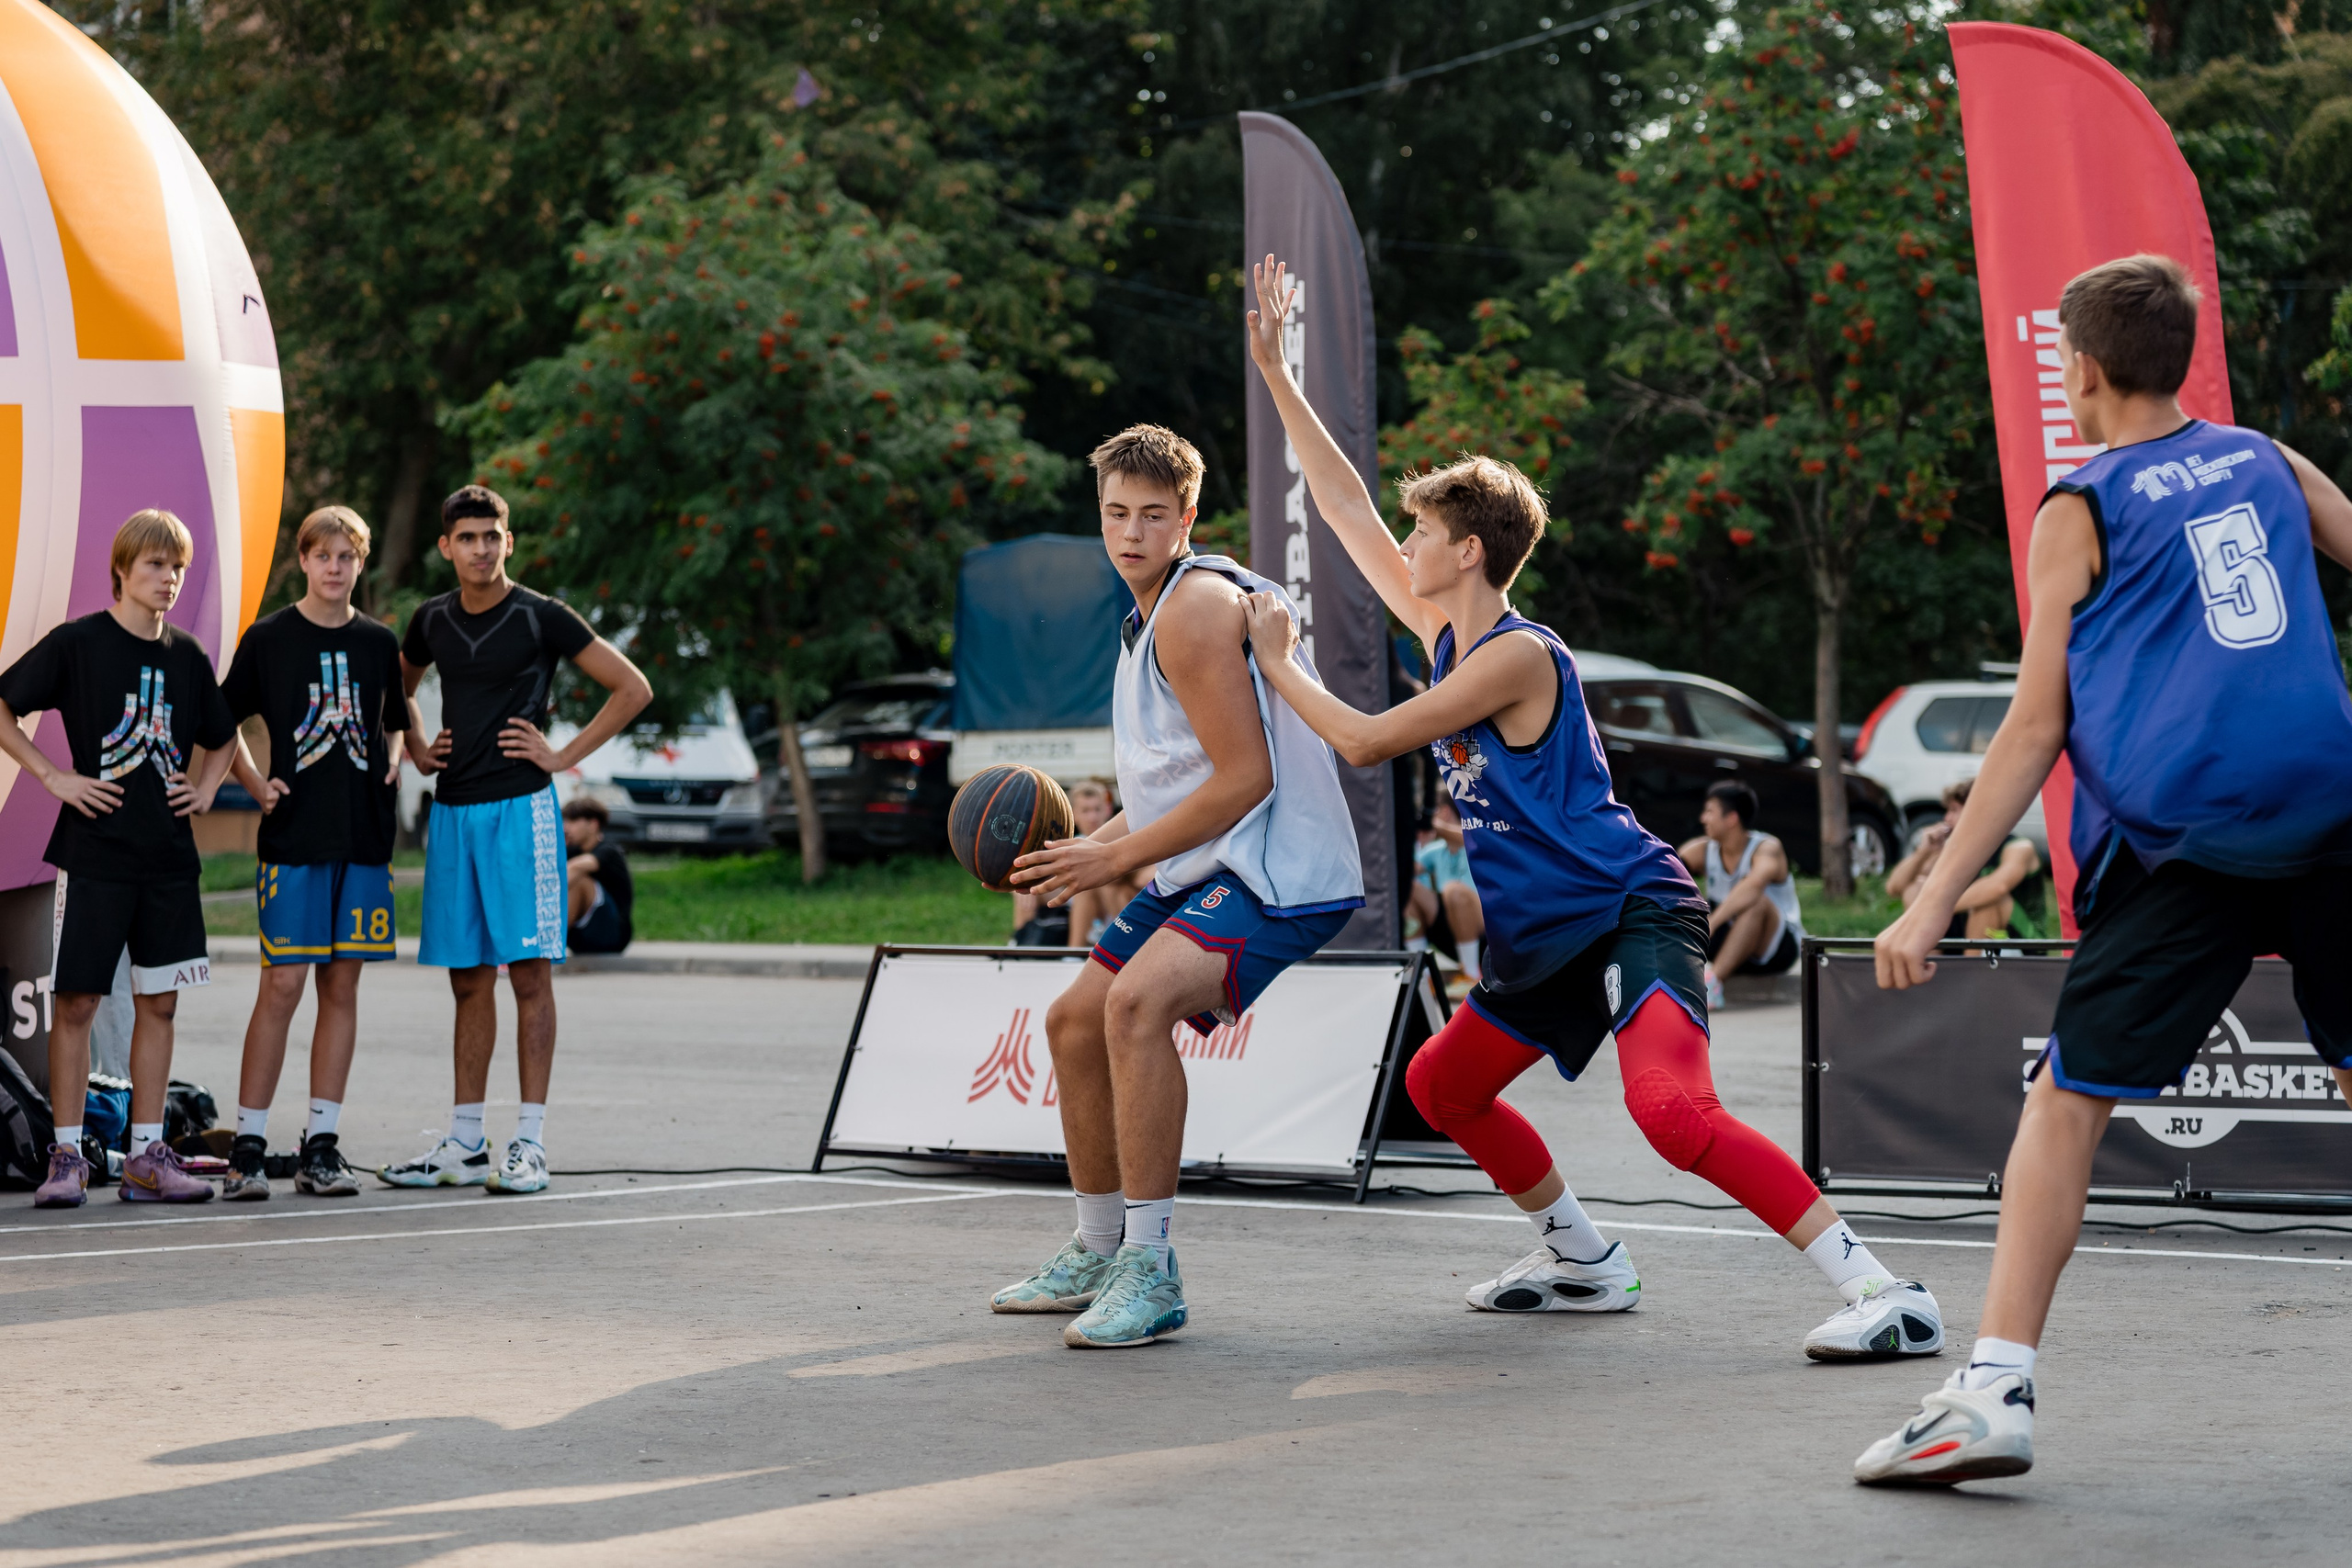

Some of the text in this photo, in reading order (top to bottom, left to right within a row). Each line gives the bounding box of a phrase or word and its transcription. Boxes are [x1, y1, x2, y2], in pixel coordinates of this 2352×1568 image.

[2183, 501, 2288, 649] 5
[1201, 886, 1231, 909] 5
[350, 907, 390, 942] 18
[174, 964, 209, 987] AIR
[2165, 1117, 2203, 1134] .RU
